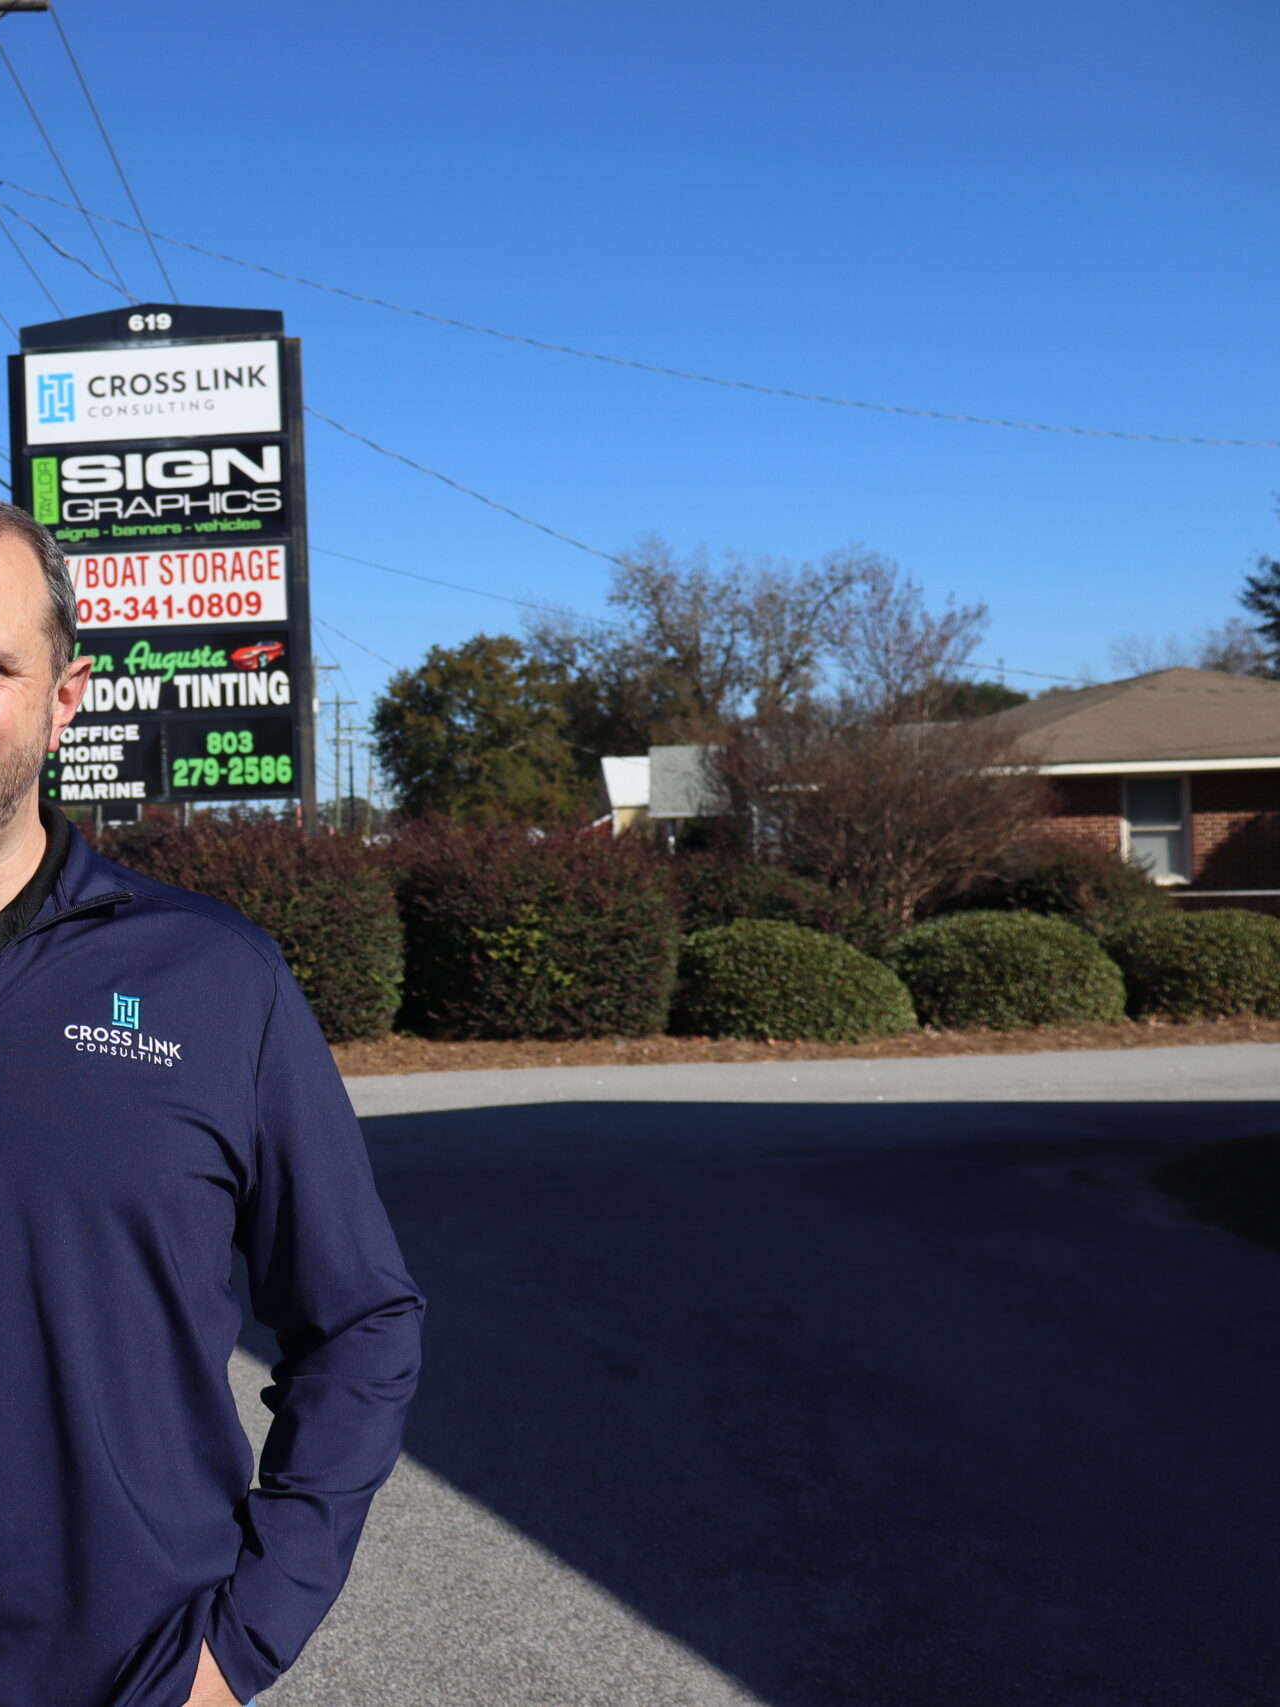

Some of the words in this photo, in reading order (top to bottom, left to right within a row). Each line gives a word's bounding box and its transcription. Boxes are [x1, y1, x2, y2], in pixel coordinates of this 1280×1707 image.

[128, 313, 172, 332] 619
[87, 371, 186, 398] CROSS
[196, 365, 267, 391] LINK
[87, 399, 215, 418] CONSULTING
[61, 446, 281, 493] SIGN
[37, 461, 54, 518] TAYLOR
[62, 489, 282, 523] GRAPHICS
[55, 526, 100, 542] signs
[111, 523, 183, 537] banners
[194, 518, 262, 533] vehicles
[66, 555, 149, 592] /BOAT
[159, 549, 281, 586] STORAGE
[76, 591, 262, 624] 03-341-0809
[124, 640, 228, 683] Augusta
[76, 676, 161, 712] NDOW
[173, 670, 290, 708] TINTING
[60, 724, 140, 744] OFFICE
[206, 730, 254, 755] 803
[60, 745, 124, 763] HOME
[172, 754, 292, 787] 279-2586
[61, 763, 119, 782] AUTO
[61, 781, 146, 800] MARINE
[64, 1024, 132, 1046] CROSS
[138, 1033, 182, 1060] LINK
[75, 1042, 173, 1067] CONSULTING
